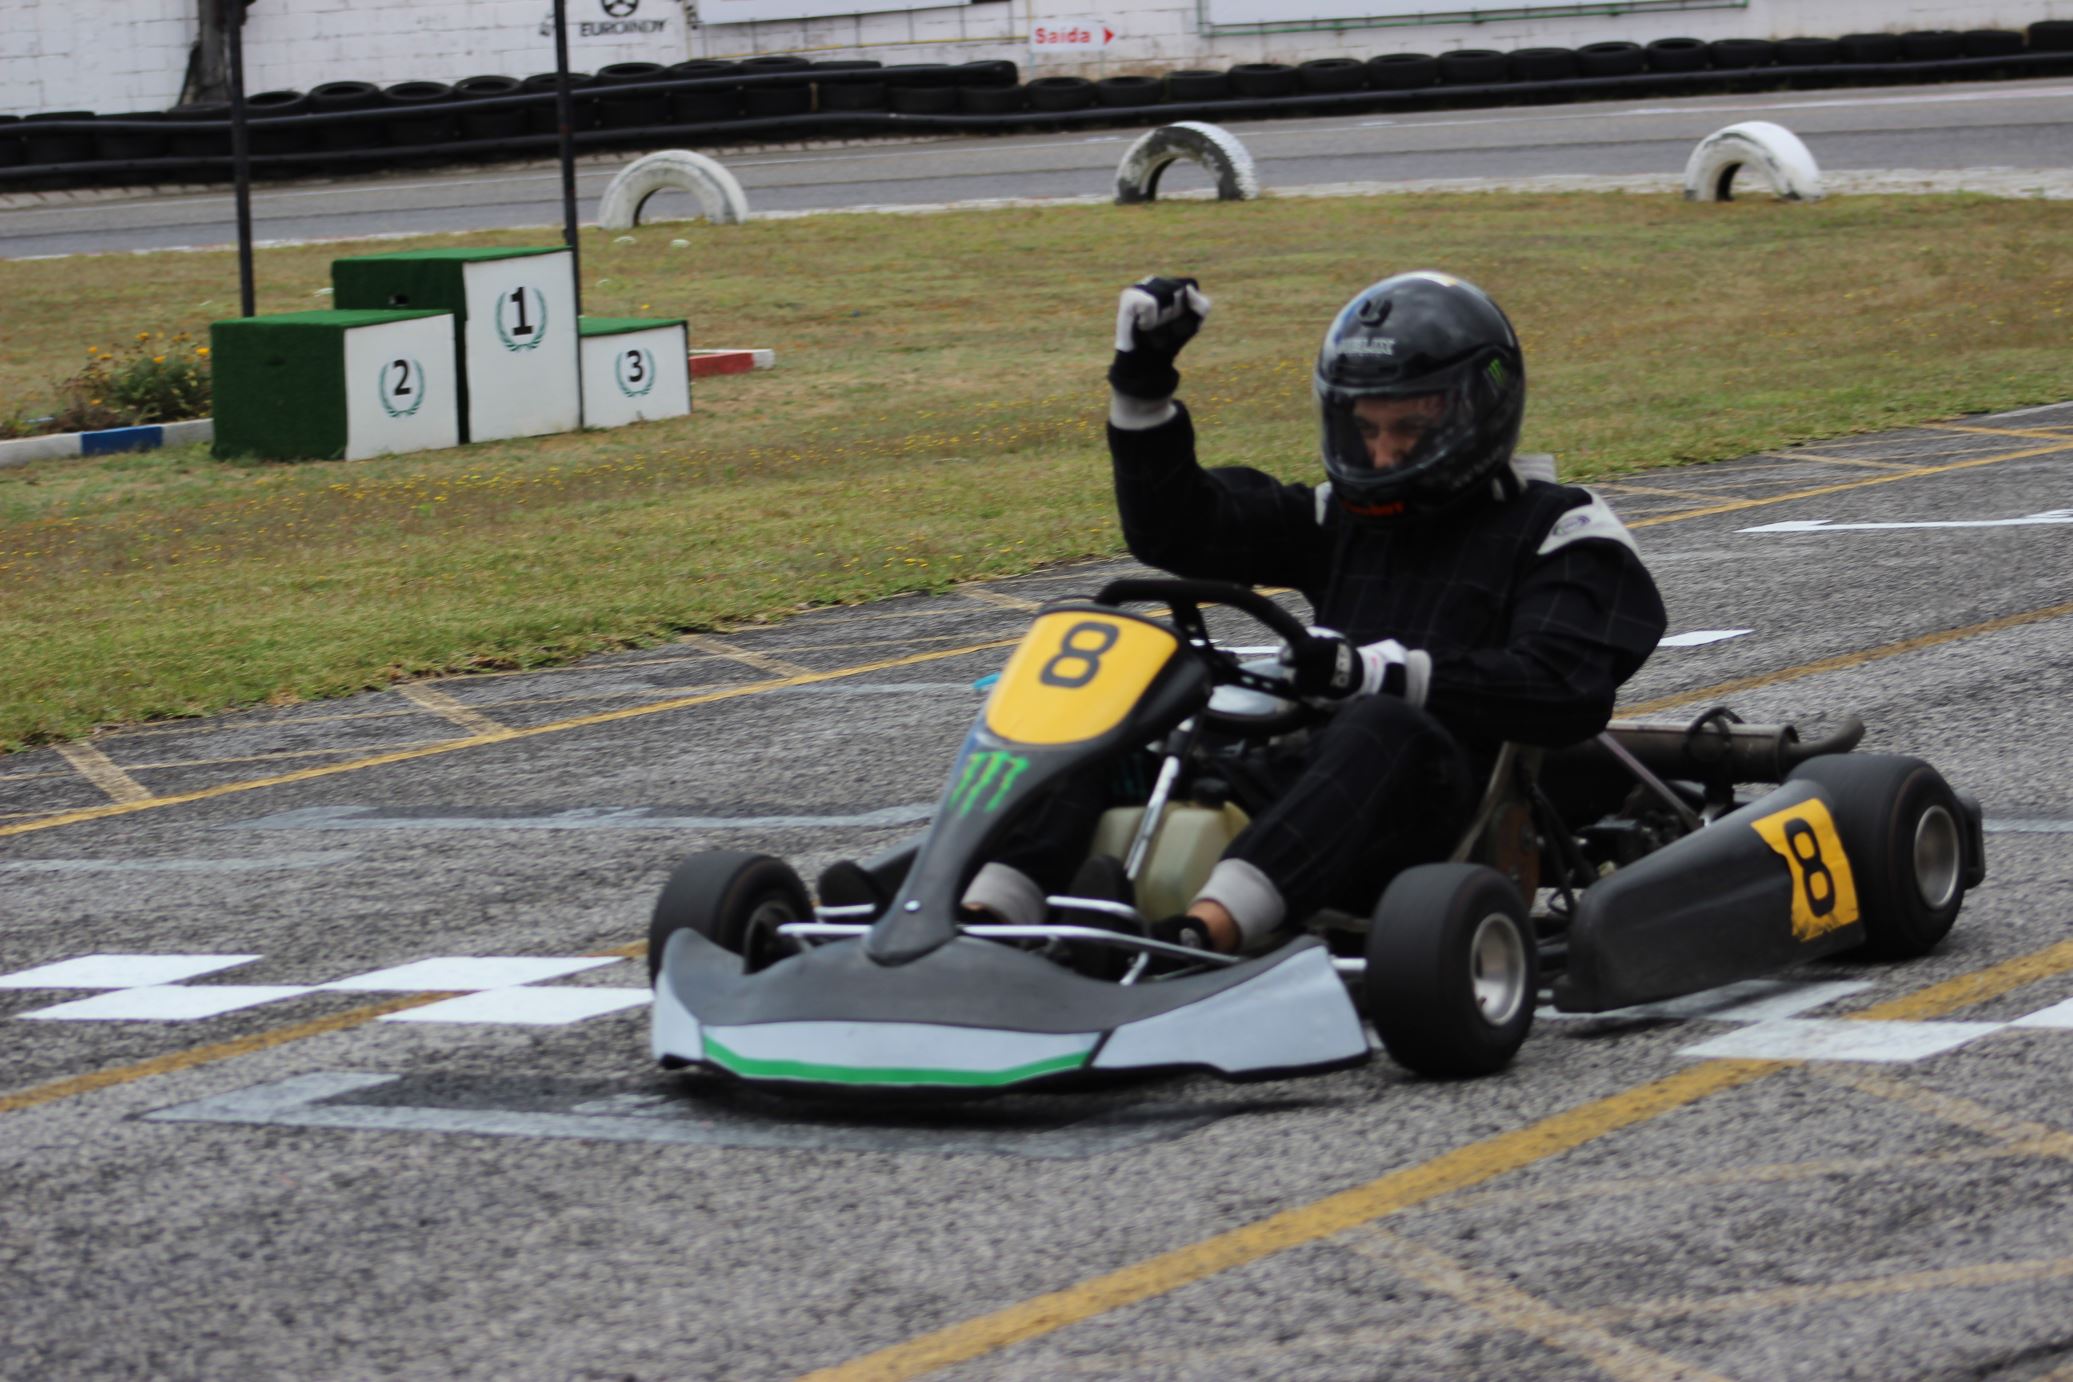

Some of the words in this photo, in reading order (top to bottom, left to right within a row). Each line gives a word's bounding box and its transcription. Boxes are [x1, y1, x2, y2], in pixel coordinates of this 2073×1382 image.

[510, 287, 533, 335] 1
[392, 359, 412, 396] 2
[627, 350, 644, 382] 3
[1040, 621, 1119, 688] 8
[1784, 818, 1835, 917] 8
